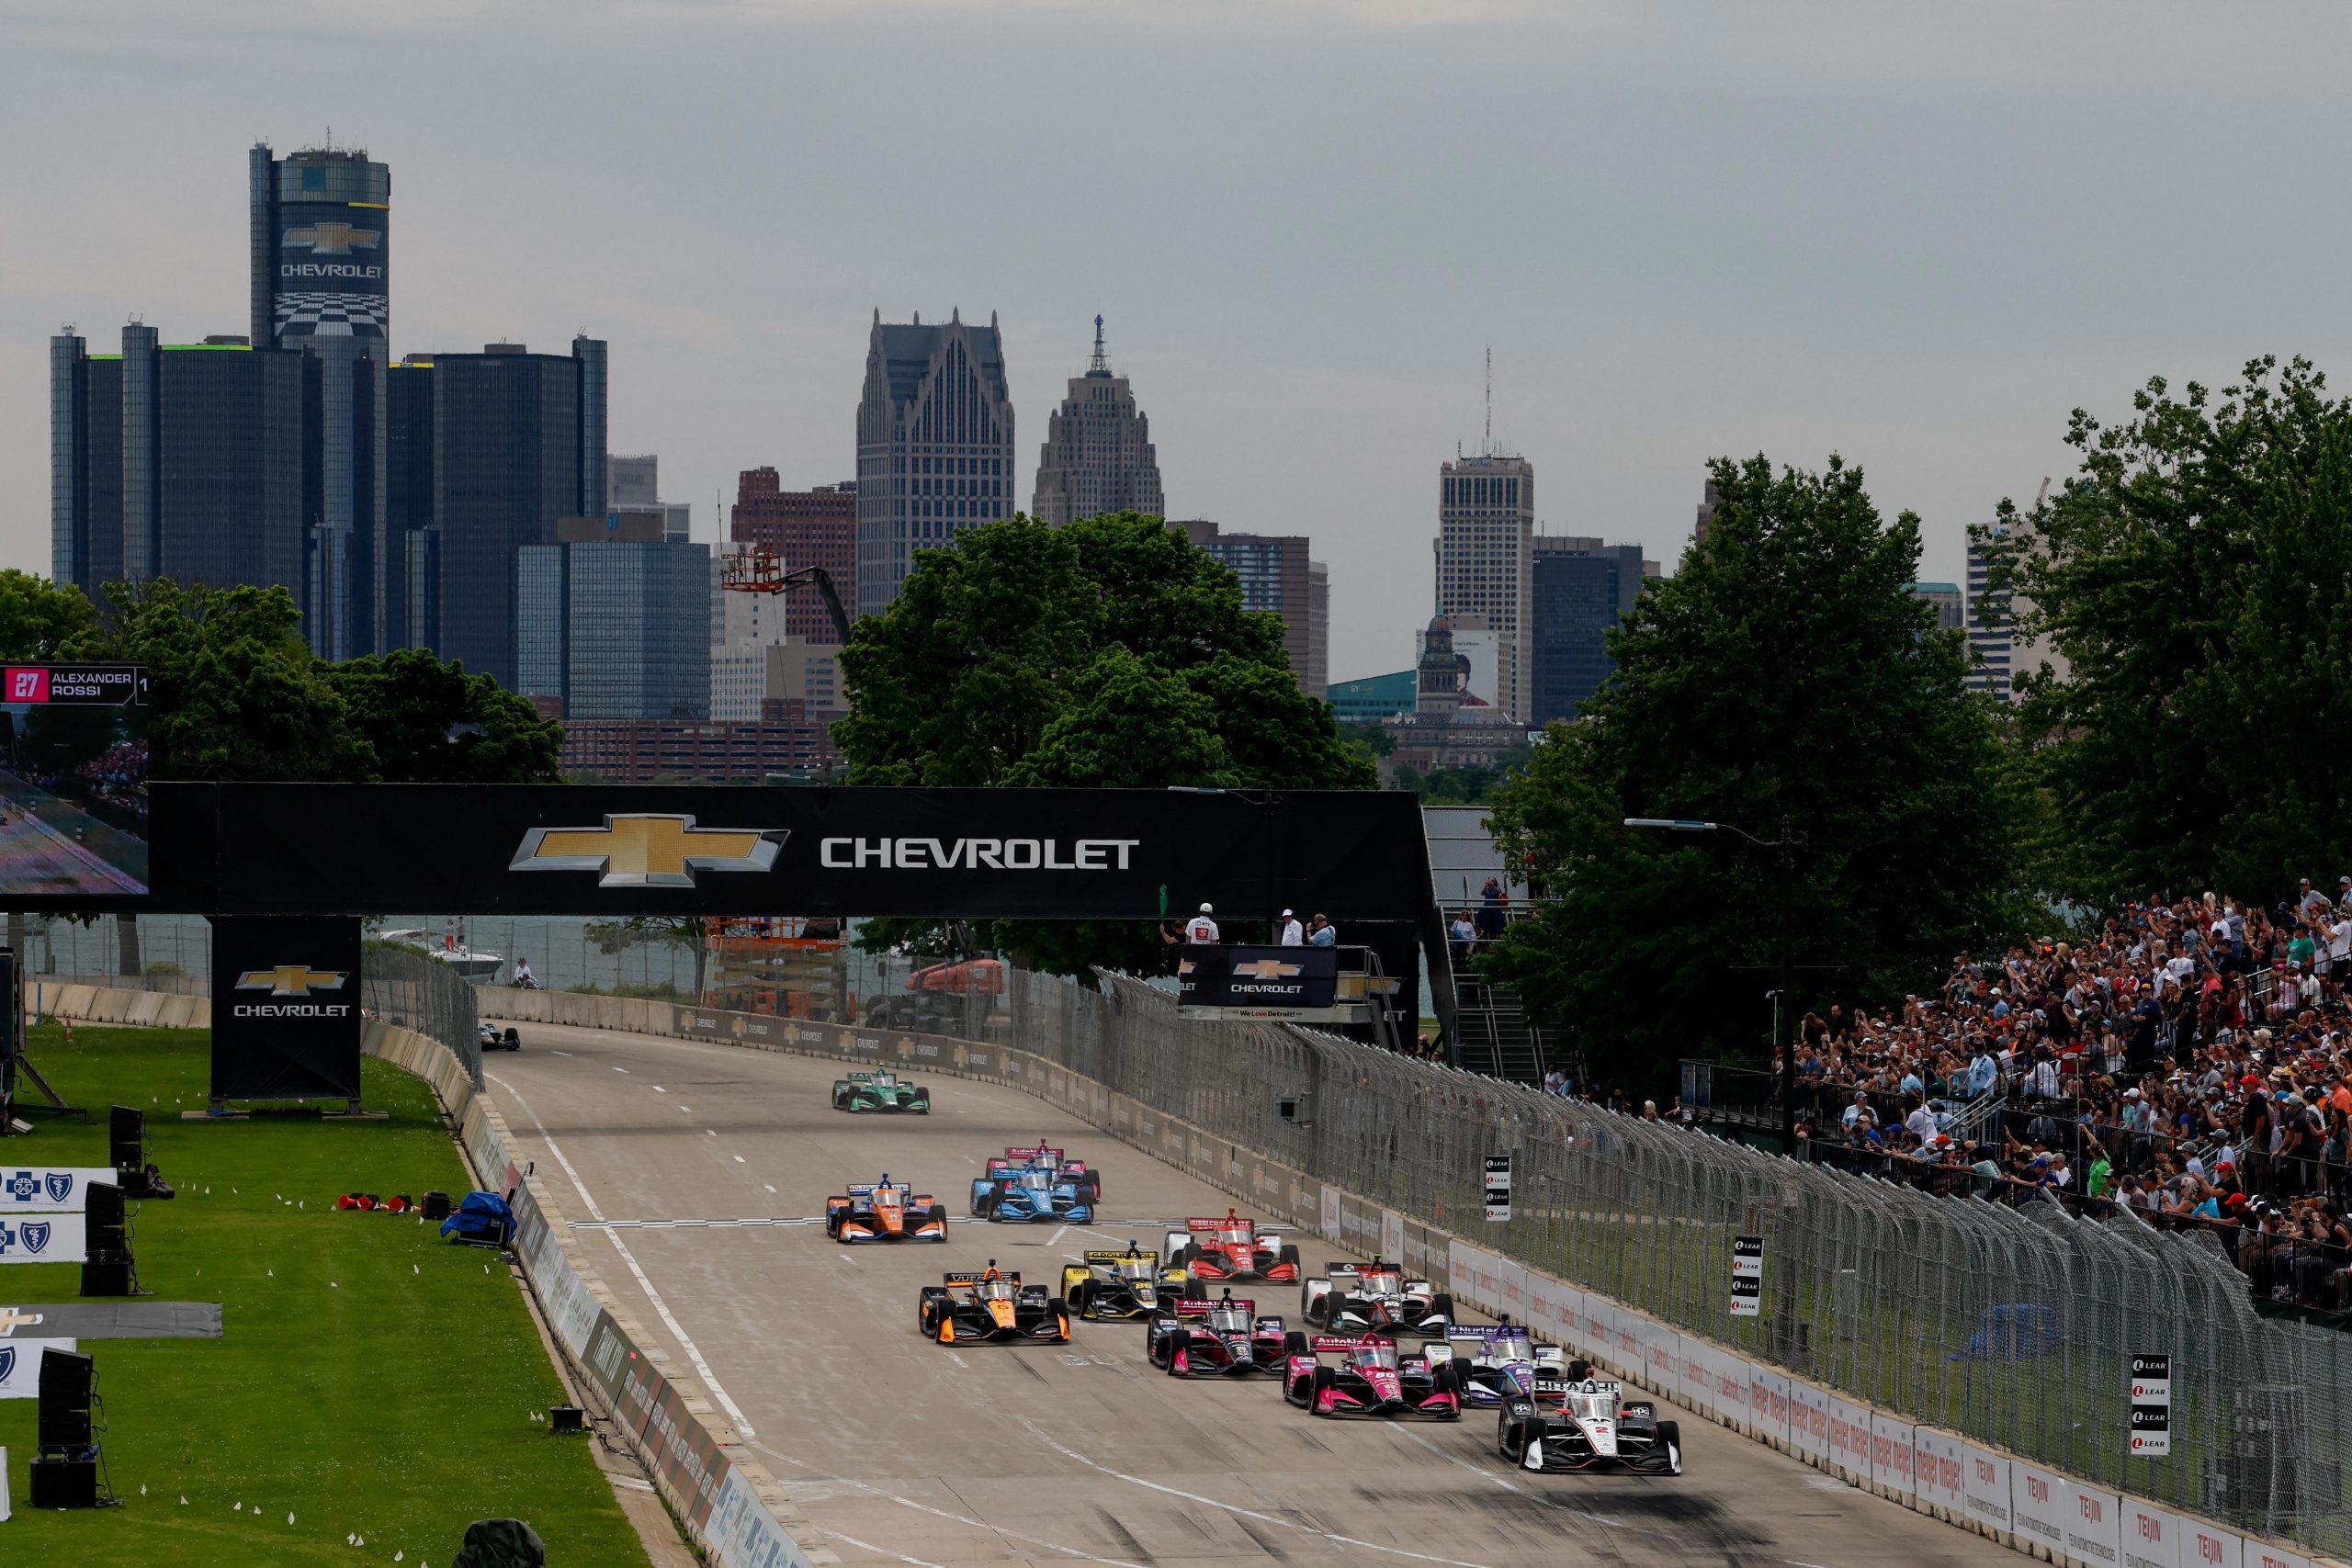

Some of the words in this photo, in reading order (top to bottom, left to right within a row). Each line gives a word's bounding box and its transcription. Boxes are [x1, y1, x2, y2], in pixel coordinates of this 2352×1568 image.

[281, 264, 382, 278] CHEVROLET
[15, 673, 39, 697] 27
[52, 673, 131, 684] ALEXANDER
[52, 685, 101, 696] ROSSI
[140, 678, 147, 692] 1
[820, 837, 1140, 870] CHEVROLET
[1230, 984, 1304, 994] CHEVROLET
[233, 1005, 350, 1017] CHEVROLET
[1714, 1371, 1748, 1405] visitdetroit.com
[1751, 1374, 1769, 1421] meijer
[1770, 1384, 1787, 1431] meijer
[1792, 1392, 1808, 1438] meijer
[1810, 1399, 1826, 1448] meijer
[1831, 1408, 1849, 1457] meijer
[1850, 1416, 1869, 1466] meijer
[1873, 1426, 1892, 1477] meijer
[1893, 1431, 1911, 1483] meijer
[1917, 1440, 1937, 1493] meijer
[1939, 1448, 1961, 1500] meijer
[1975, 1458, 1996, 1485] TEIJIN
[2027, 1475, 2049, 1504] TEIJIN
[2079, 1495, 2102, 1524] TEIJIN
[2137, 1514, 2161, 1543] TEIJIN
[2197, 1533, 2222, 1563] TEIJIN
